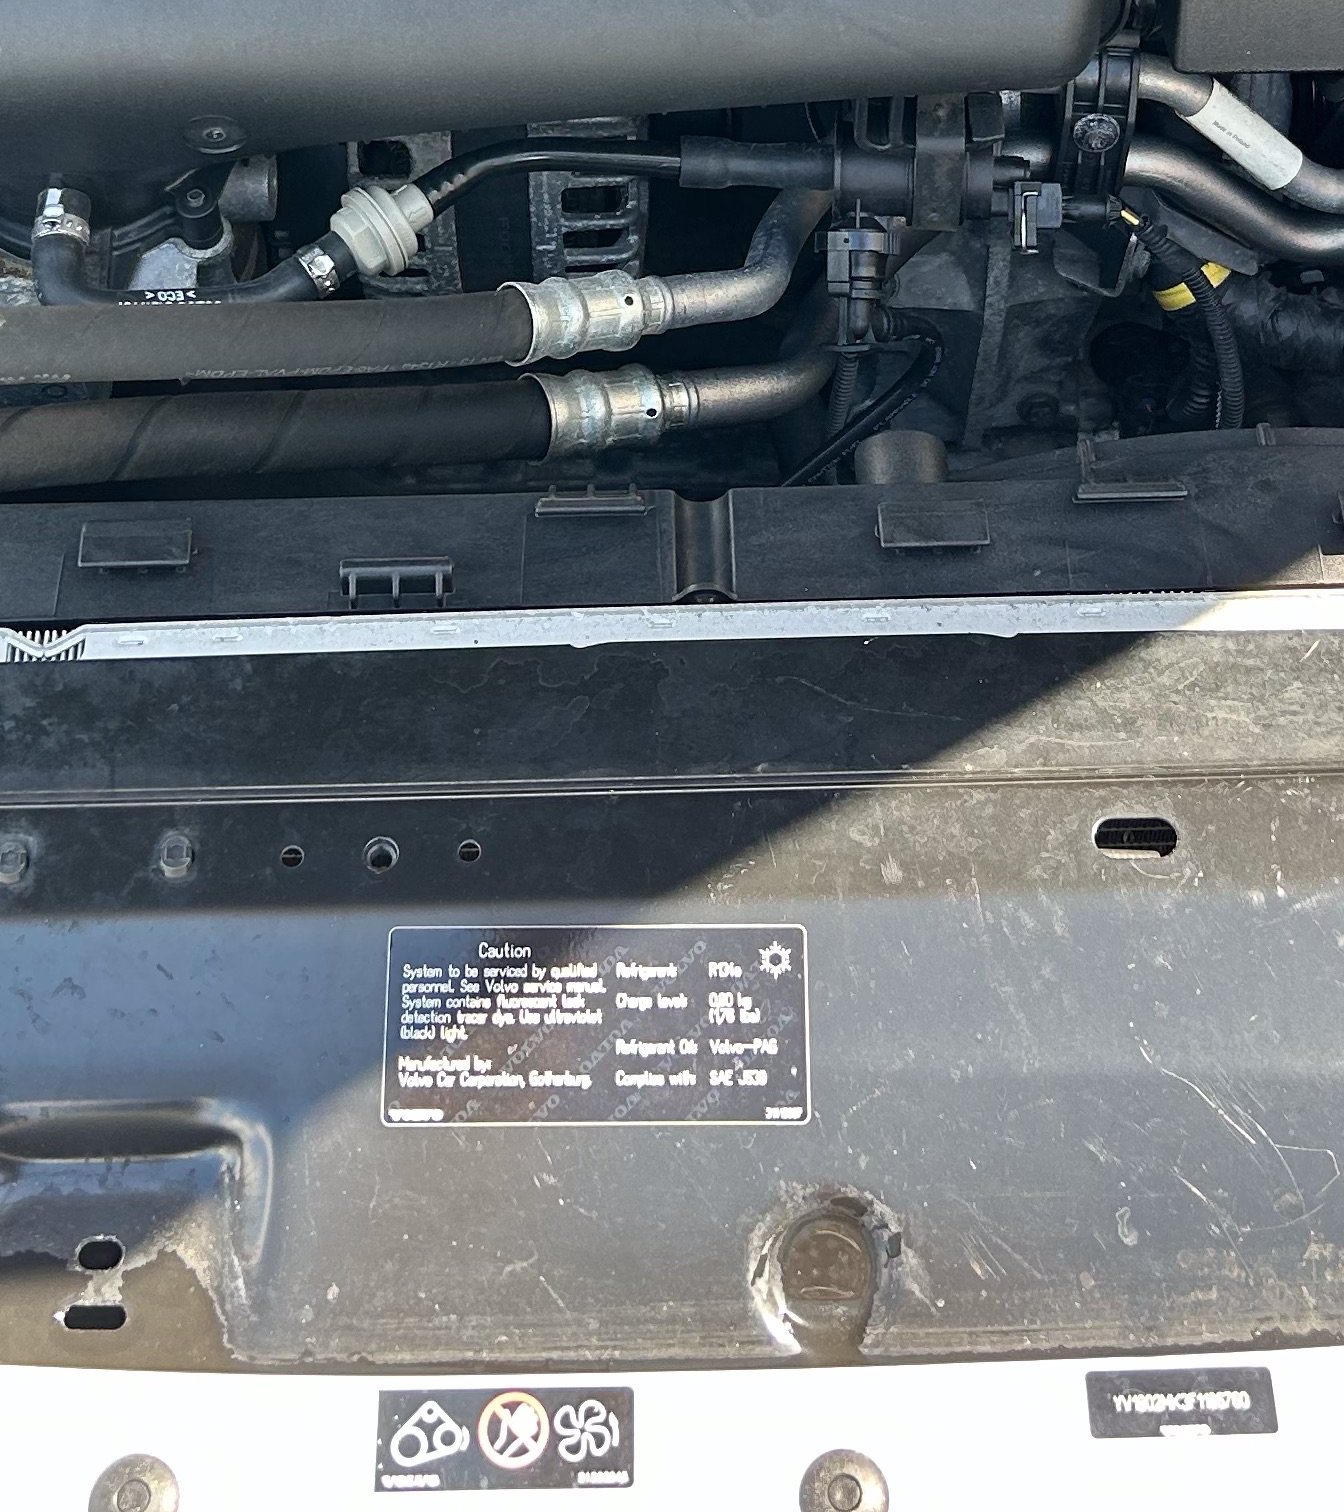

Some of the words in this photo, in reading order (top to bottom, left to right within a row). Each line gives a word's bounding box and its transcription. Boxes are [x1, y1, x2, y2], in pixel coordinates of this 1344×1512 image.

[478, 942, 532, 959] Caution
[403, 964, 442, 979] System
[448, 966, 460, 977] to
[464, 965, 479, 977] be
[484, 964, 528, 978] serviced
[532, 964, 547, 980] by
[550, 962, 598, 979] qualified
[401, 981, 454, 995] personnel.
[459, 980, 480, 993] See
[485, 980, 519, 993] Volvo
[522, 981, 563, 993] service
[401, 995, 441, 1009] System
[445, 996, 492, 1008] contains
[401, 1010, 452, 1024] detection
[519, 1010, 541, 1024] Use
[400, 1026, 436, 1040] (black)
[398, 1073, 433, 1088] Volvo
[437, 1071, 456, 1088] Car
[709, 1070, 734, 1087] SAE
